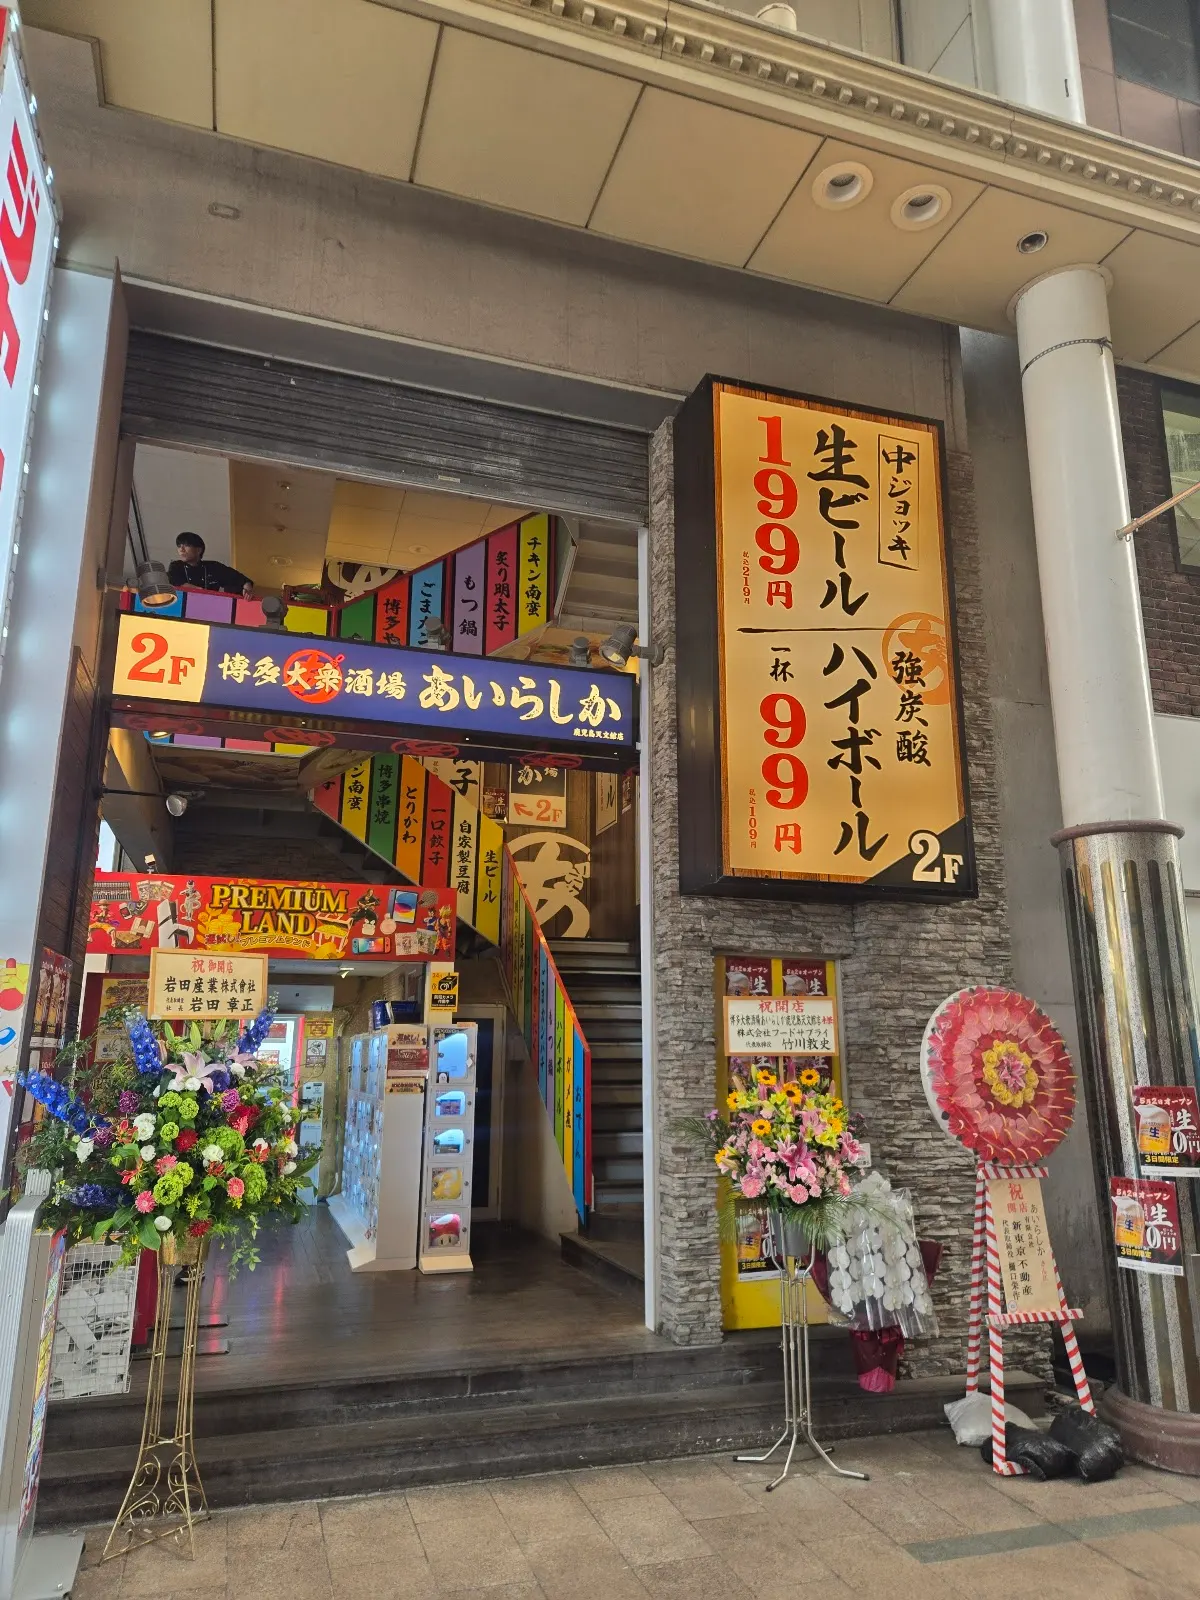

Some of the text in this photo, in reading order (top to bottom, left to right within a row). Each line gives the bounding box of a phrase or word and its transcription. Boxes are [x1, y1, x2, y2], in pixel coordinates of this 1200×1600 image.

[754, 416, 800, 609] 199円
[807, 423, 870, 616] 生ビール
[459, 575, 478, 637] もつ鍋
[492, 551, 510, 631] 炙り明太子
[524, 536, 541, 617] チキン南蛮
[127, 632, 195, 685] 2F
[217, 652, 622, 727] 博多大衆酒場 あいらしか
[891, 651, 932, 767] 強炭酸
[760, 647, 809, 855] 一杯 99円
[822, 643, 889, 862] ハイボール
[373, 763, 393, 825] 博多串焼
[402, 785, 416, 845] とりかわ
[536, 799, 563, 822] 2F
[429, 808, 444, 866] 一口餃子
[455, 820, 472, 895] 自家製豆腐
[908, 829, 964, 883] 2F
[209, 884, 349, 913] PREMIUM
[482, 850, 499, 903] 生ビール
[239, 910, 318, 936] LAND
[241, 935, 312, 948] プレミアムランド
[759, 1000, 804, 1013] 祝開店
[1172, 1108, 1197, 1131] 生
